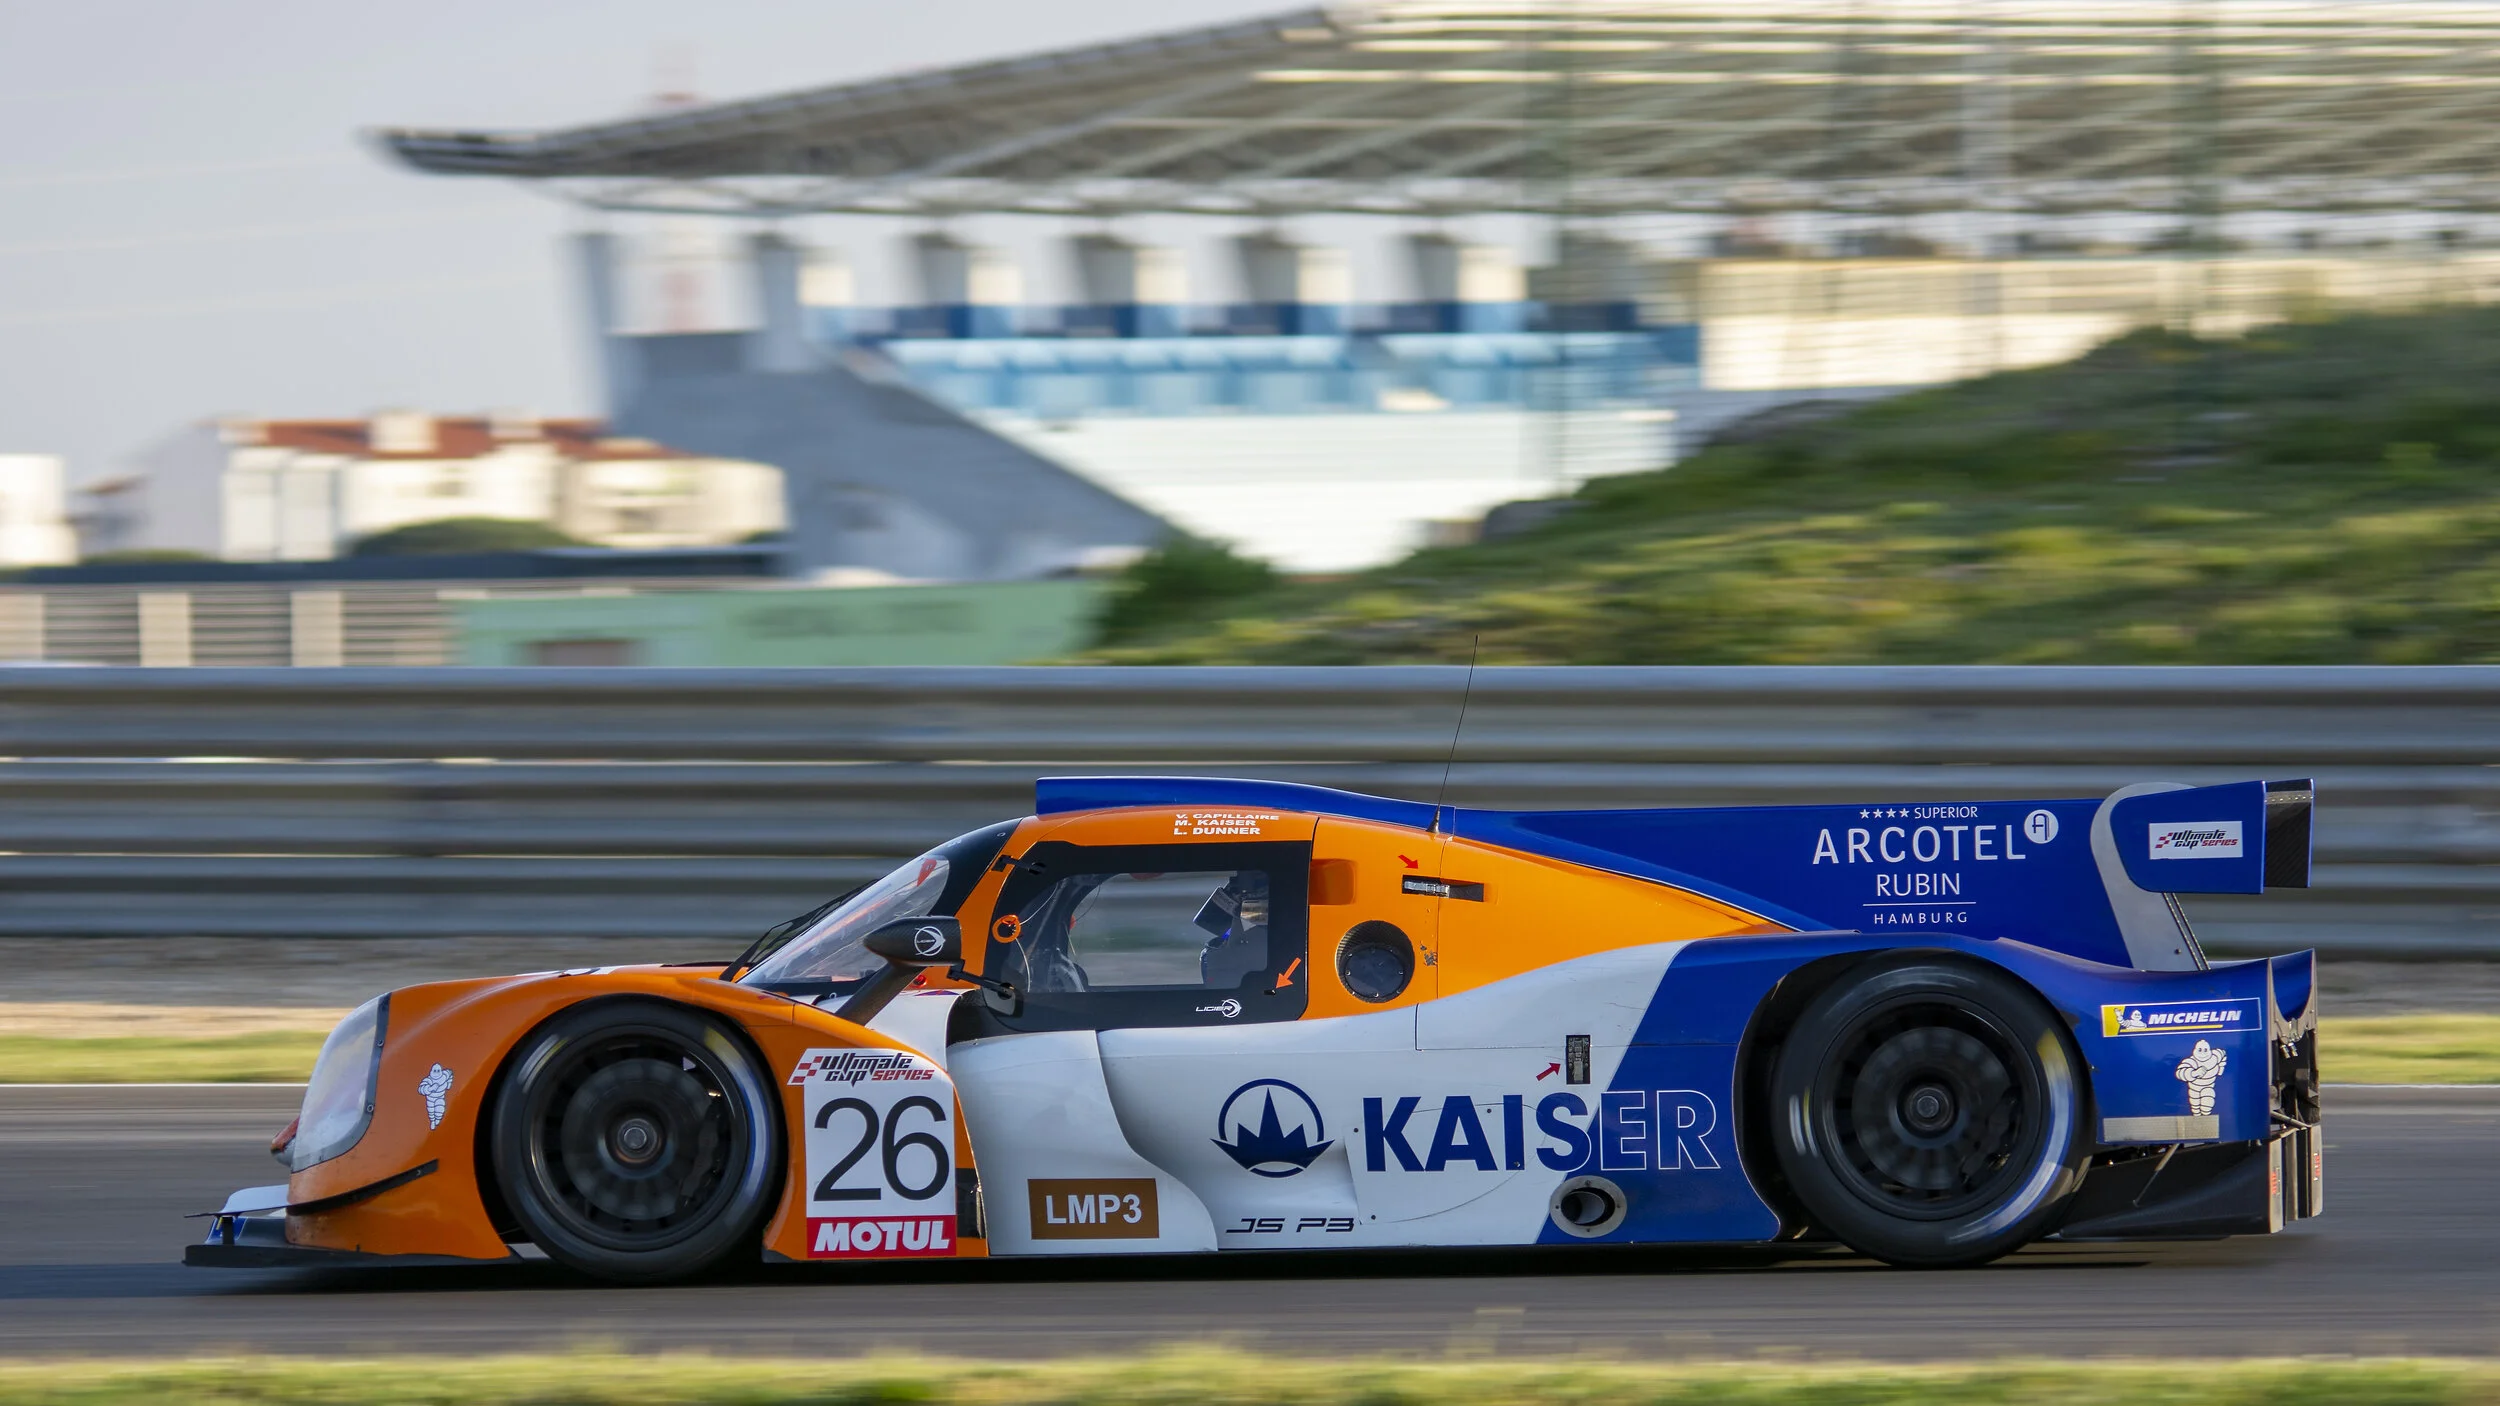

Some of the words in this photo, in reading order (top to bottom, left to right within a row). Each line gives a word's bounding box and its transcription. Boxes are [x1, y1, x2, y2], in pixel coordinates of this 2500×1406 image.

[1914, 806, 1978, 819] SUPERIOR
[1193, 827, 1260, 835] DUNNER
[1812, 824, 2026, 865] ARCOTEL
[1876, 872, 1960, 897] RUBIN
[1874, 911, 1967, 925] HAMBURG
[2148, 1010, 2242, 1025] MICHELIN
[1363, 1090, 1721, 1172] KAISER
[813, 1095, 950, 1201] 26
[1045, 1194, 1142, 1225] LMP3
[813, 1220, 950, 1252] MOTUL
[1226, 1217, 1286, 1233] JS
[1296, 1217, 1355, 1233] P3
